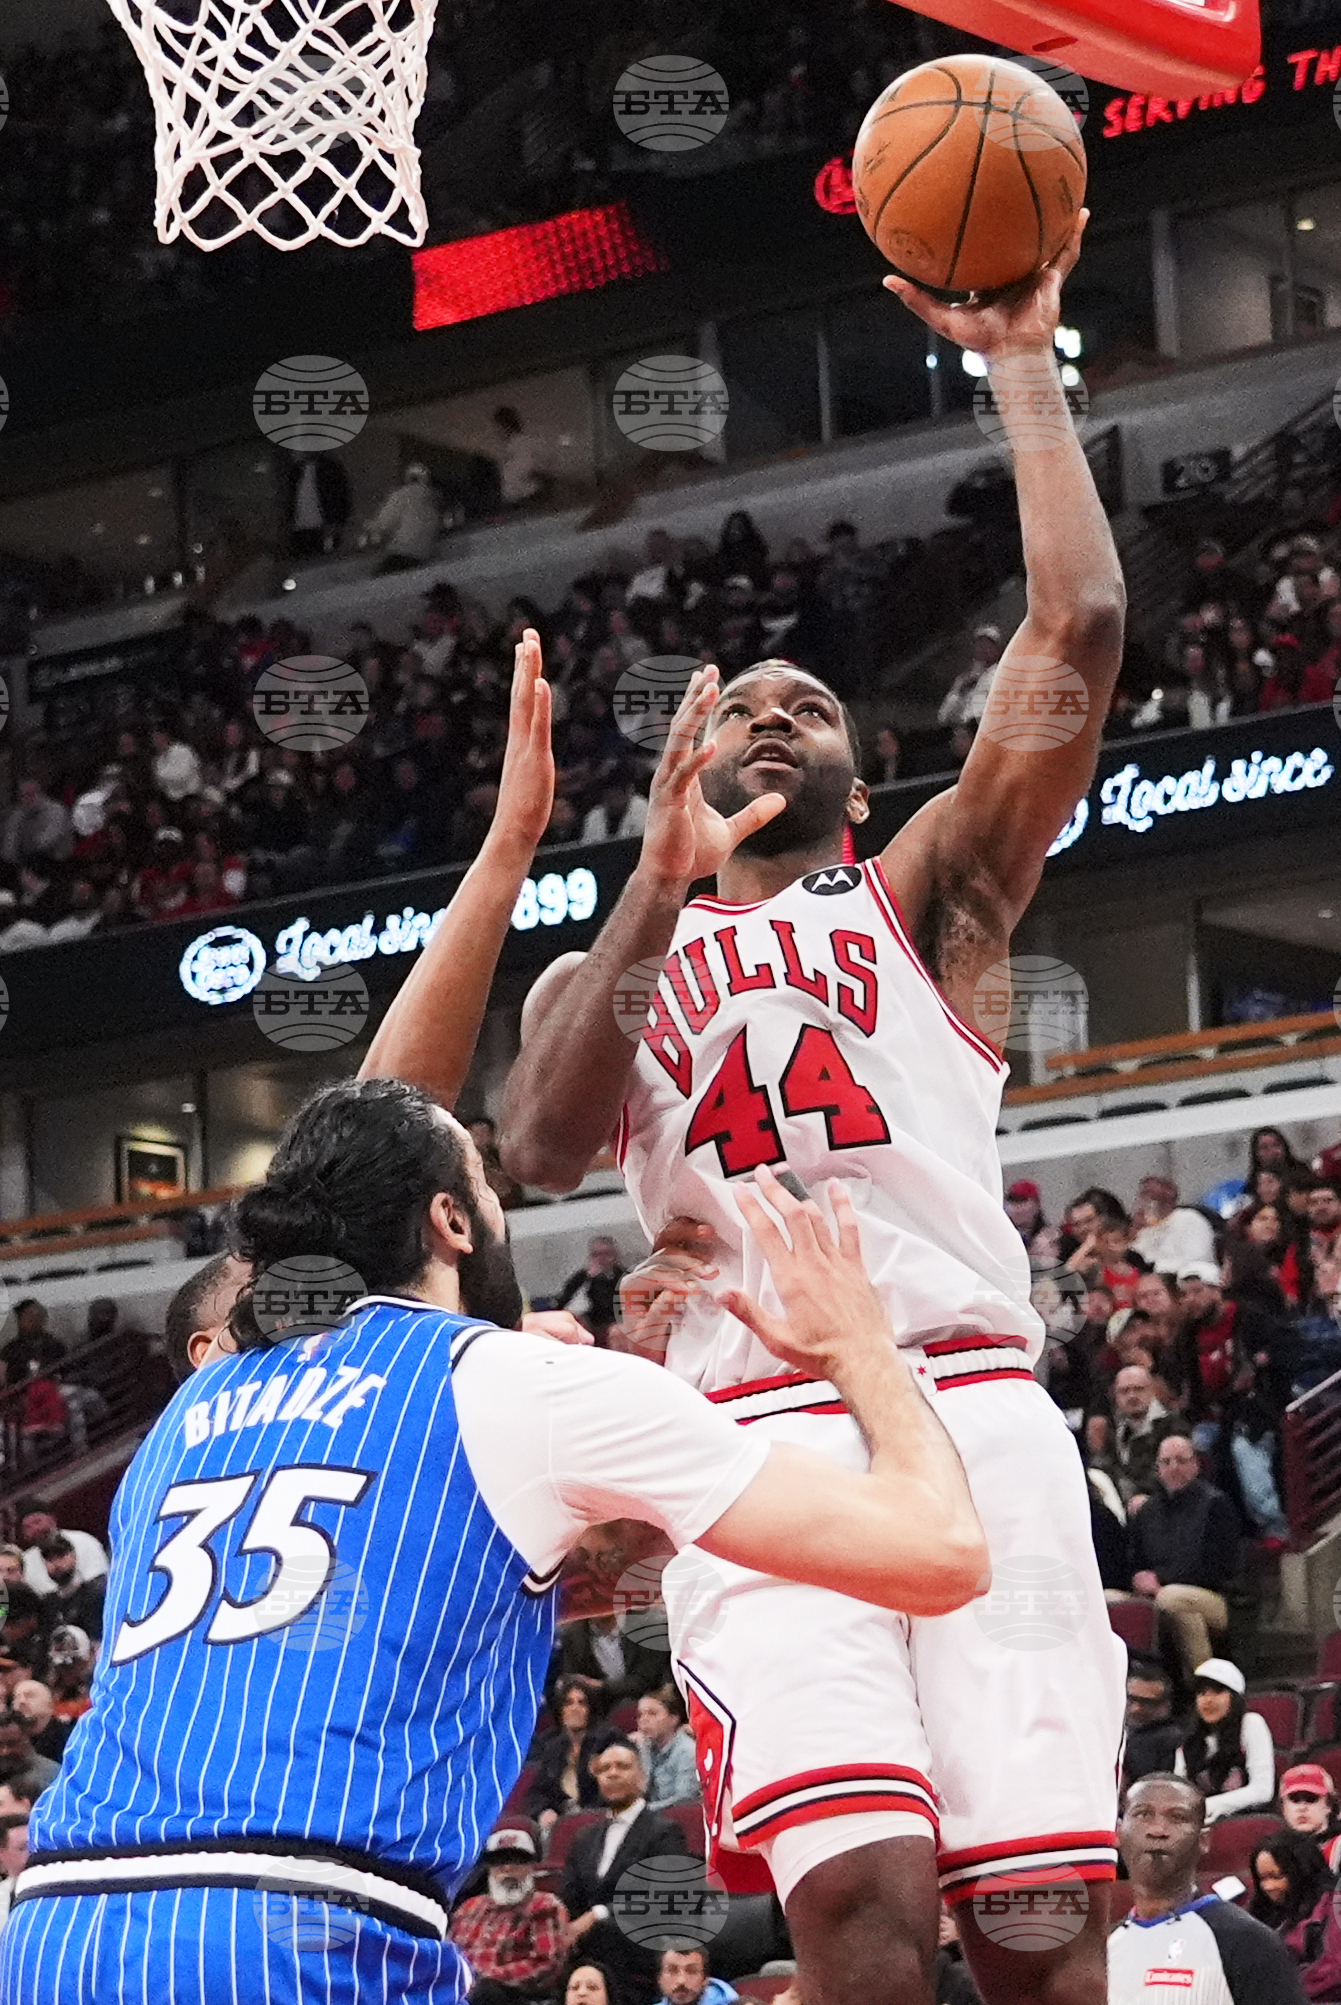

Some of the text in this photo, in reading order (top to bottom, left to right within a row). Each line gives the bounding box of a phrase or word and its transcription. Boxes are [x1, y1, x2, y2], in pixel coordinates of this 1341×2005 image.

[1100, 747, 1335, 833] Local since
[274, 910, 378, 981] Local
[511, 867, 598, 931] 899
[641, 919, 878, 1100] BULLS
[684, 1022, 892, 1179] 44
[184, 1365, 387, 1450] BITADZE
[110, 1462, 379, 1667] 35
